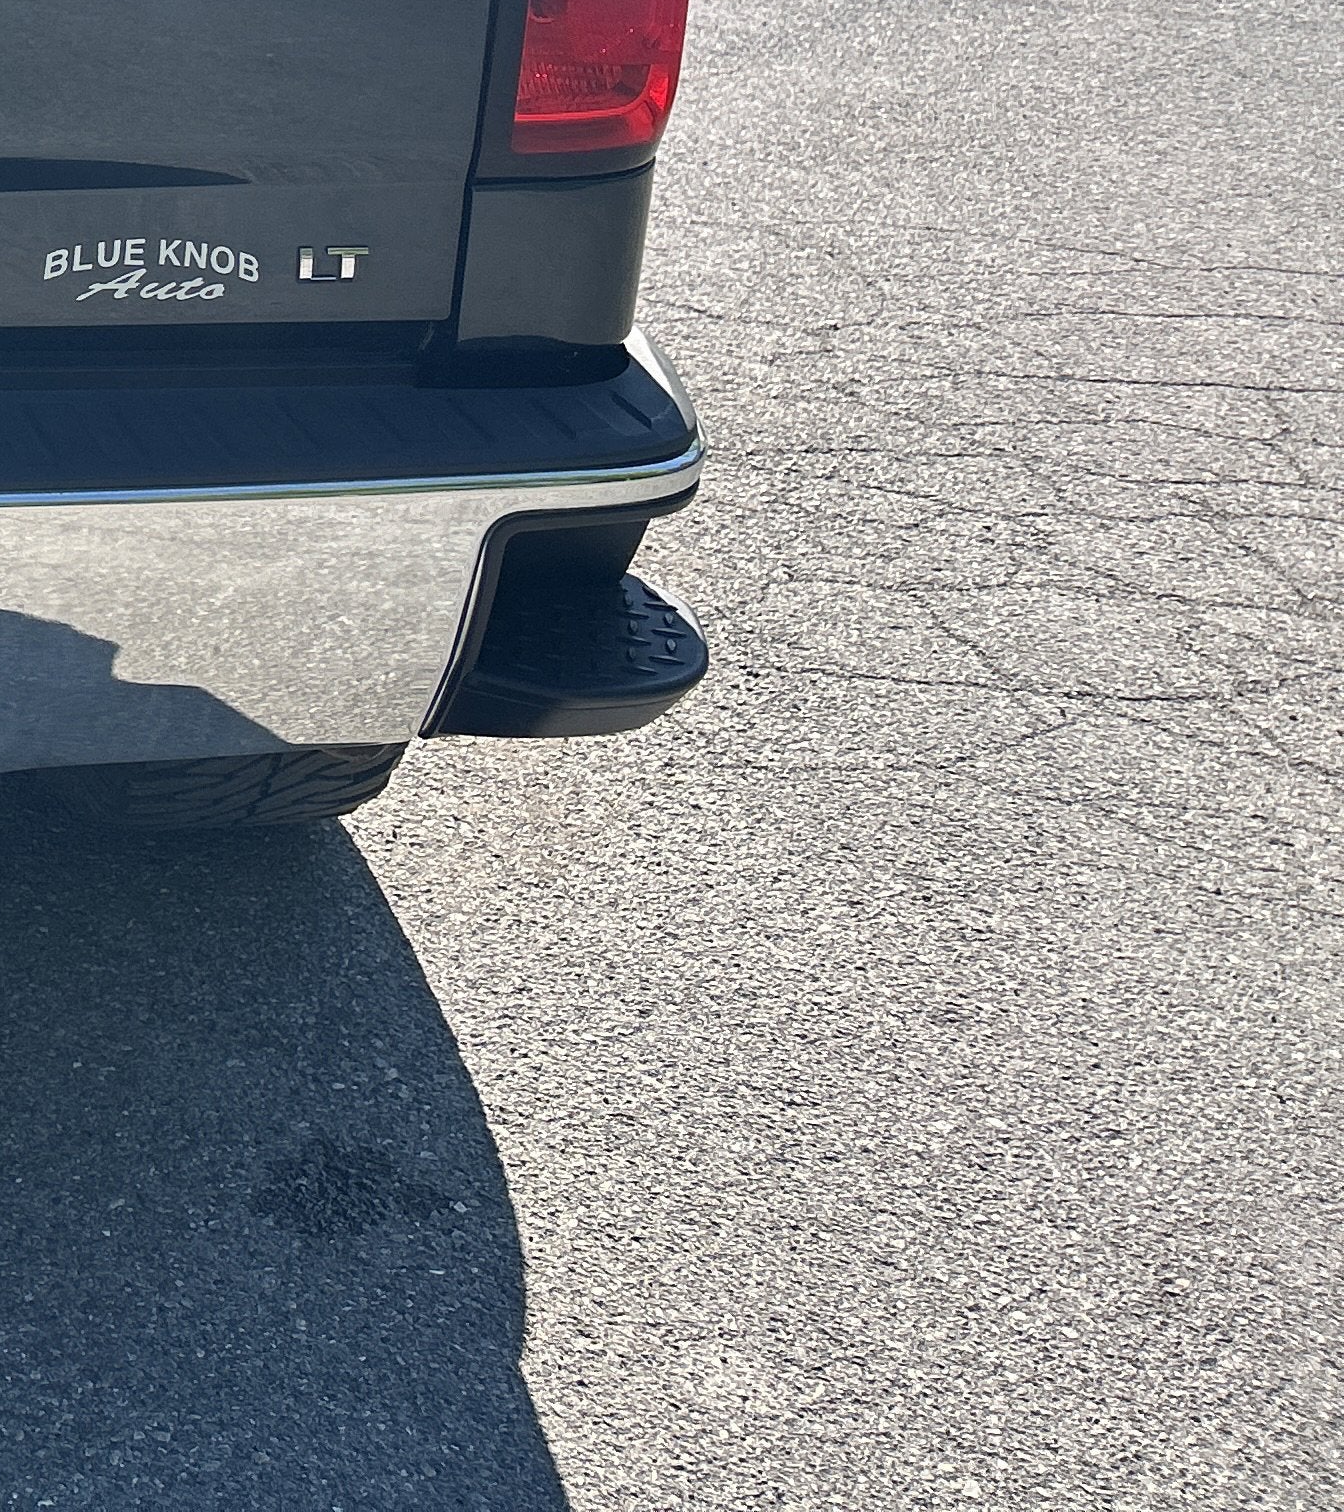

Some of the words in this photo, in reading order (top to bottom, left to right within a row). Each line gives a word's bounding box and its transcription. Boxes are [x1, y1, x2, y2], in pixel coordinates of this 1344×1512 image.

[43, 238, 146, 280] BLUE
[158, 239, 260, 283] KNOB
[299, 247, 369, 281] LT
[76, 268, 225, 301] Auto
